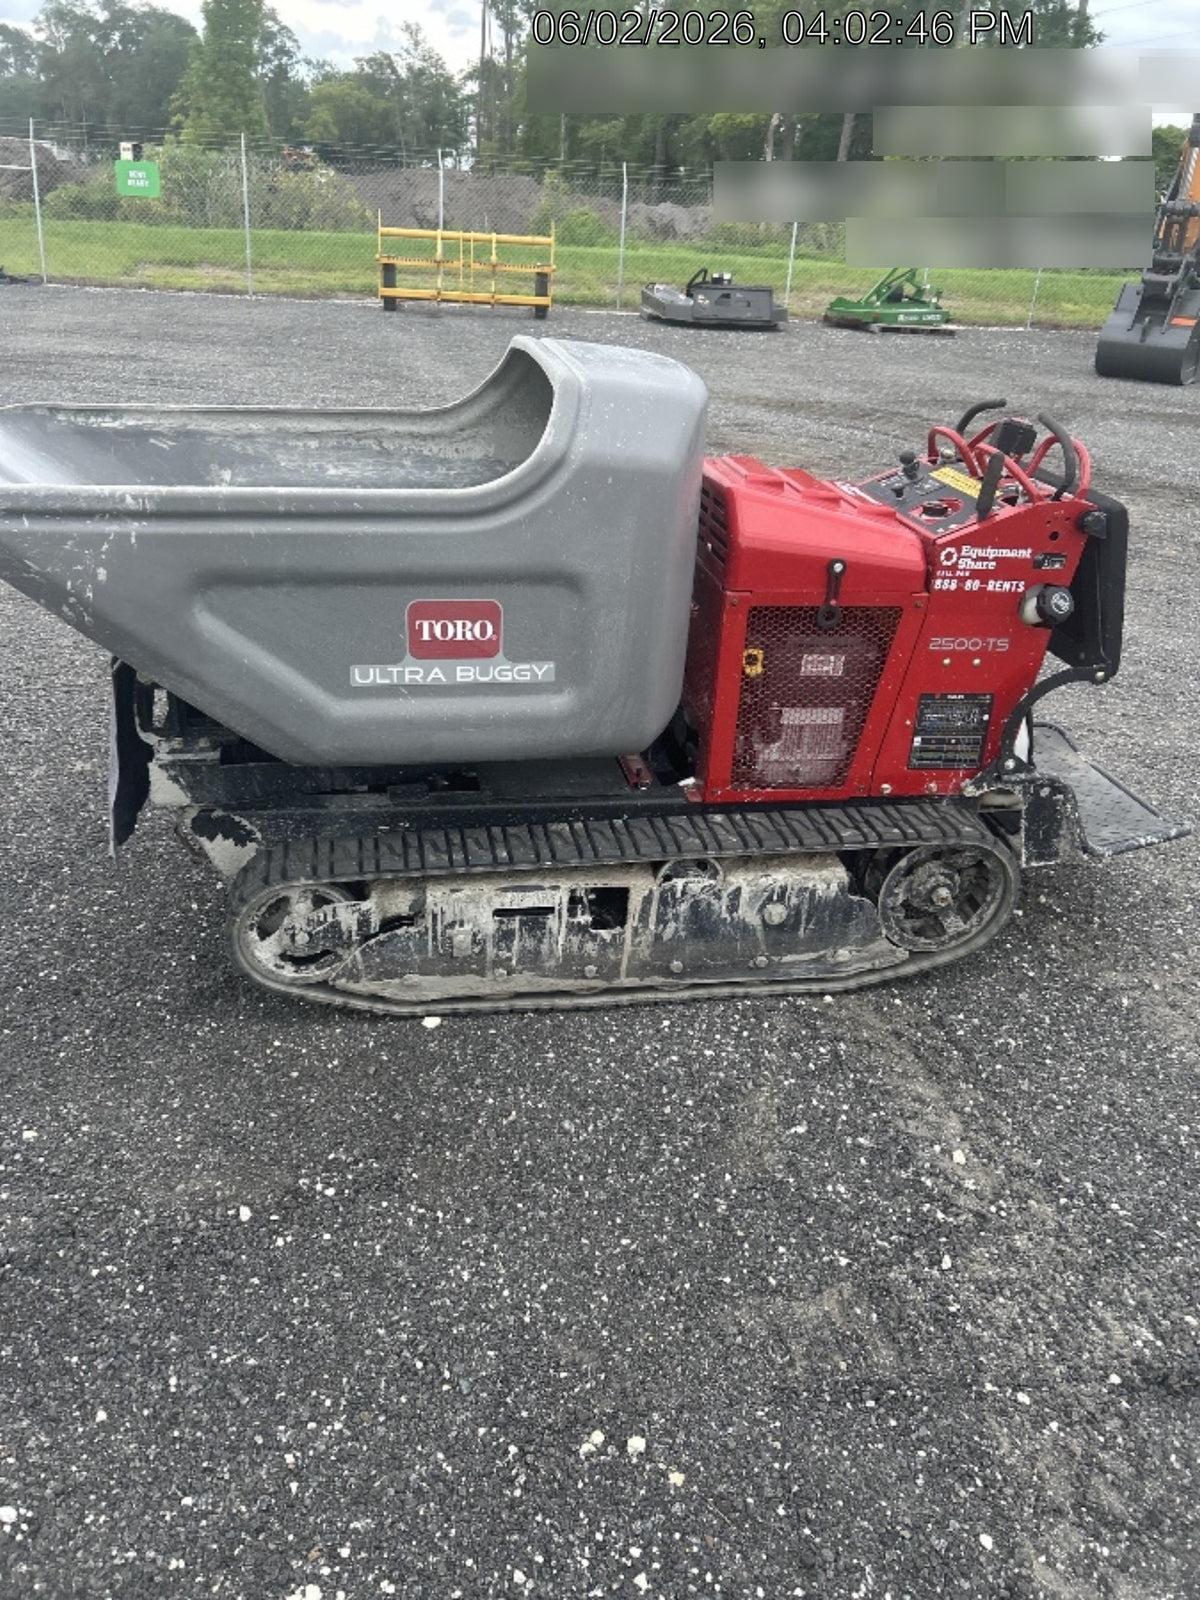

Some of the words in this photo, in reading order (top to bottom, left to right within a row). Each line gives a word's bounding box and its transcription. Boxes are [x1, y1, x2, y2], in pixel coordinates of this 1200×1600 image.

[961, 545, 1032, 559] Equipment
[958, 558, 996, 570] Share
[416, 619, 493, 641] TORO
[354, 667, 446, 684] ULTRA
[456, 664, 549, 682] BUGGY
